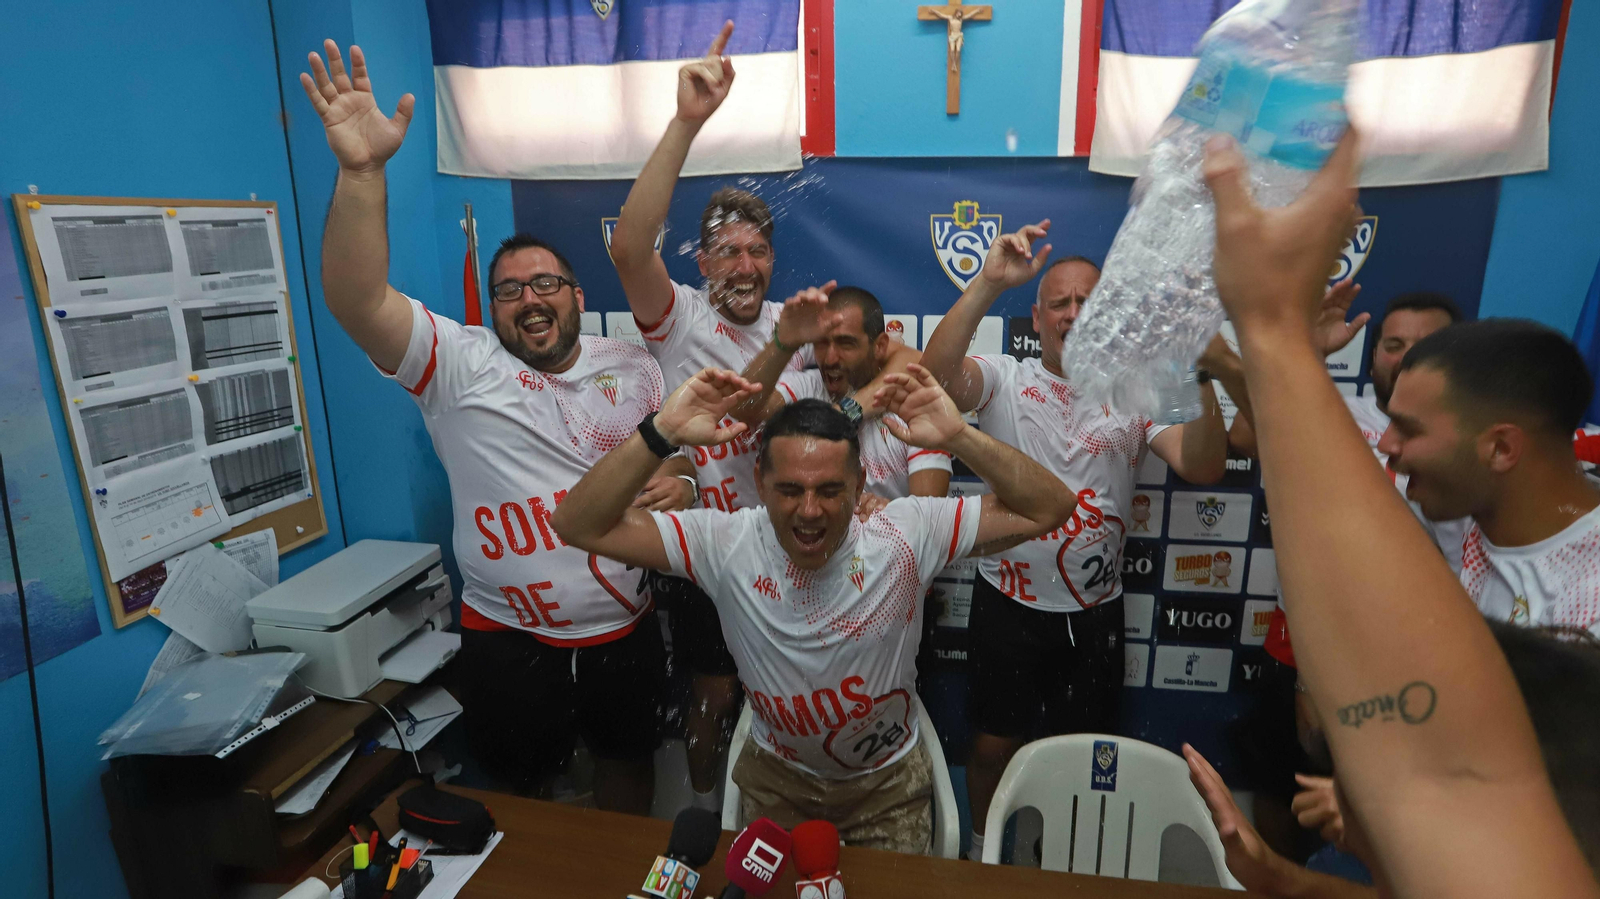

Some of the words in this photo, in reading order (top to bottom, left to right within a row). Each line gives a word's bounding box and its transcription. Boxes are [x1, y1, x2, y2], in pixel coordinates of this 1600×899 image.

[1175, 554, 1212, 571] TURBO
[999, 558, 1037, 602] DE
[1174, 568, 1210, 582] SEGUROS
[499, 581, 573, 628] DE
[1166, 611, 1232, 629] YUGO
[741, 858, 773, 883] cmm
